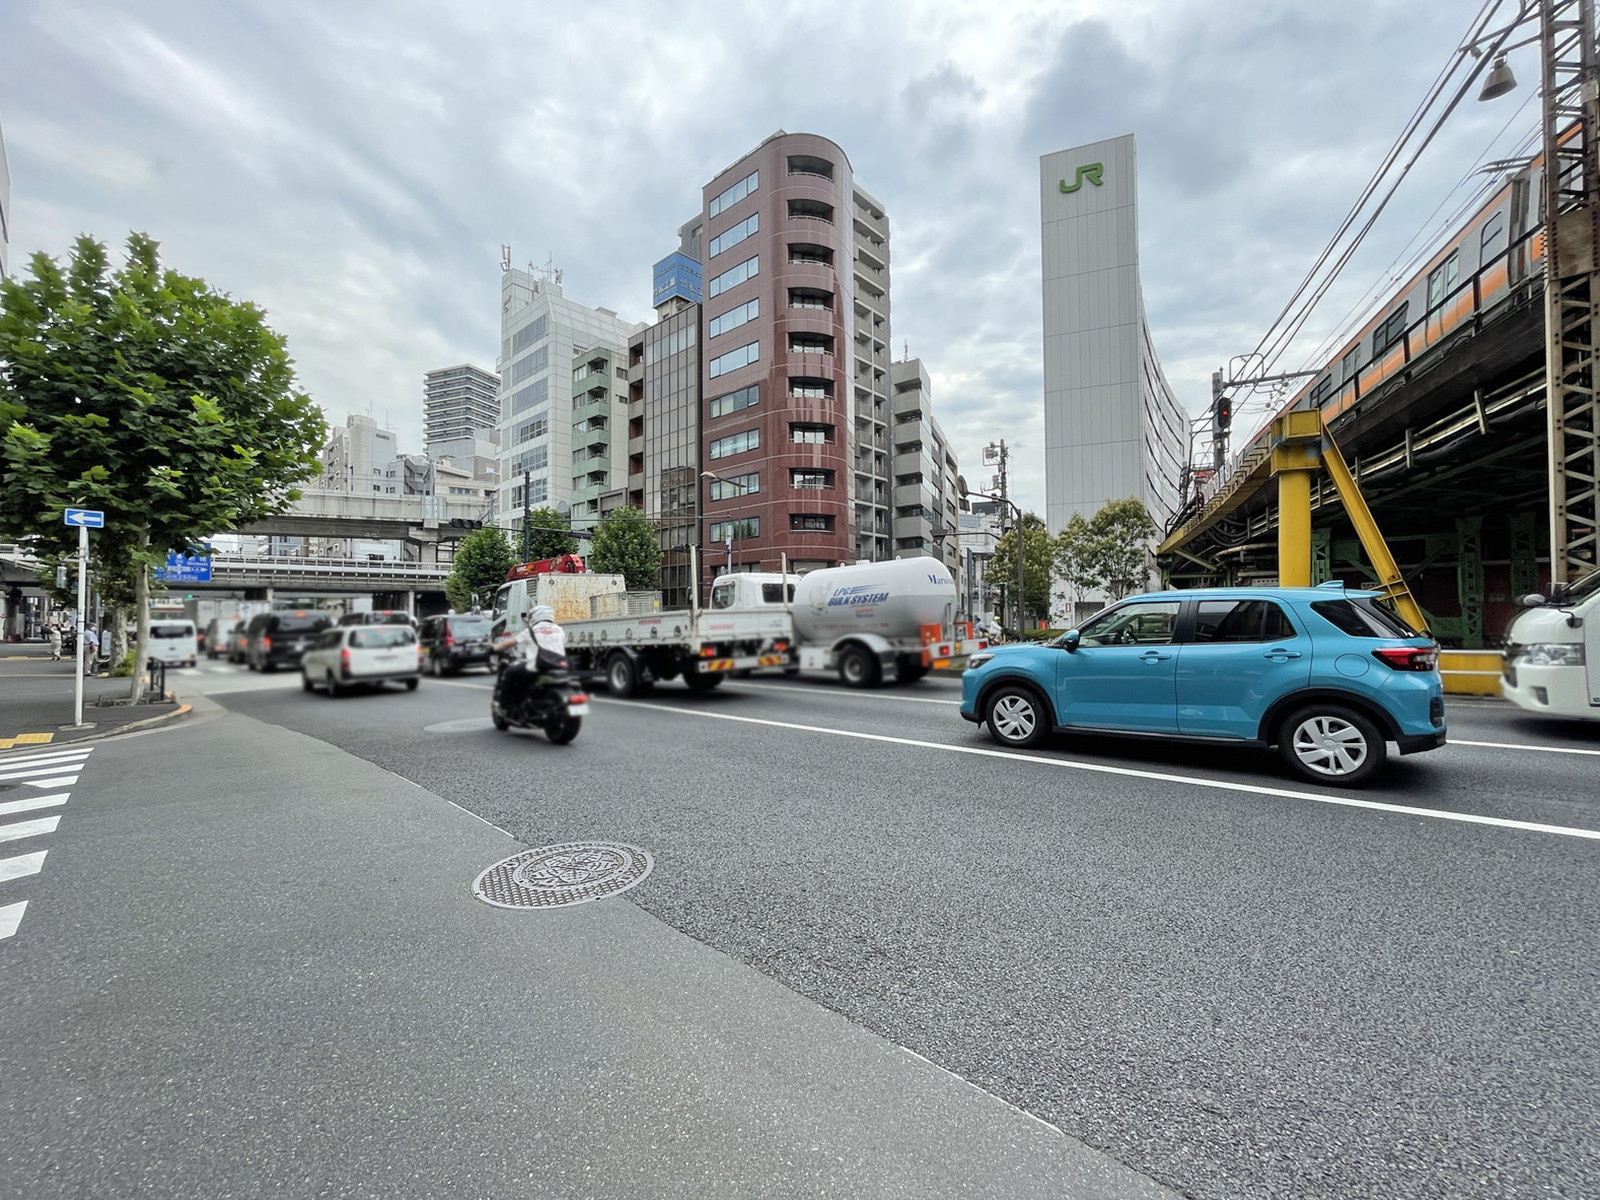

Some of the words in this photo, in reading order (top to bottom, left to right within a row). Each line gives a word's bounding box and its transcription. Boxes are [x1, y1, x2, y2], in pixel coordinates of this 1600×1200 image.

[1059, 162, 1104, 193] JR
[833, 587, 851, 596] LPG
[828, 596, 850, 606] BULK
[850, 592, 889, 605] SYSTEM
